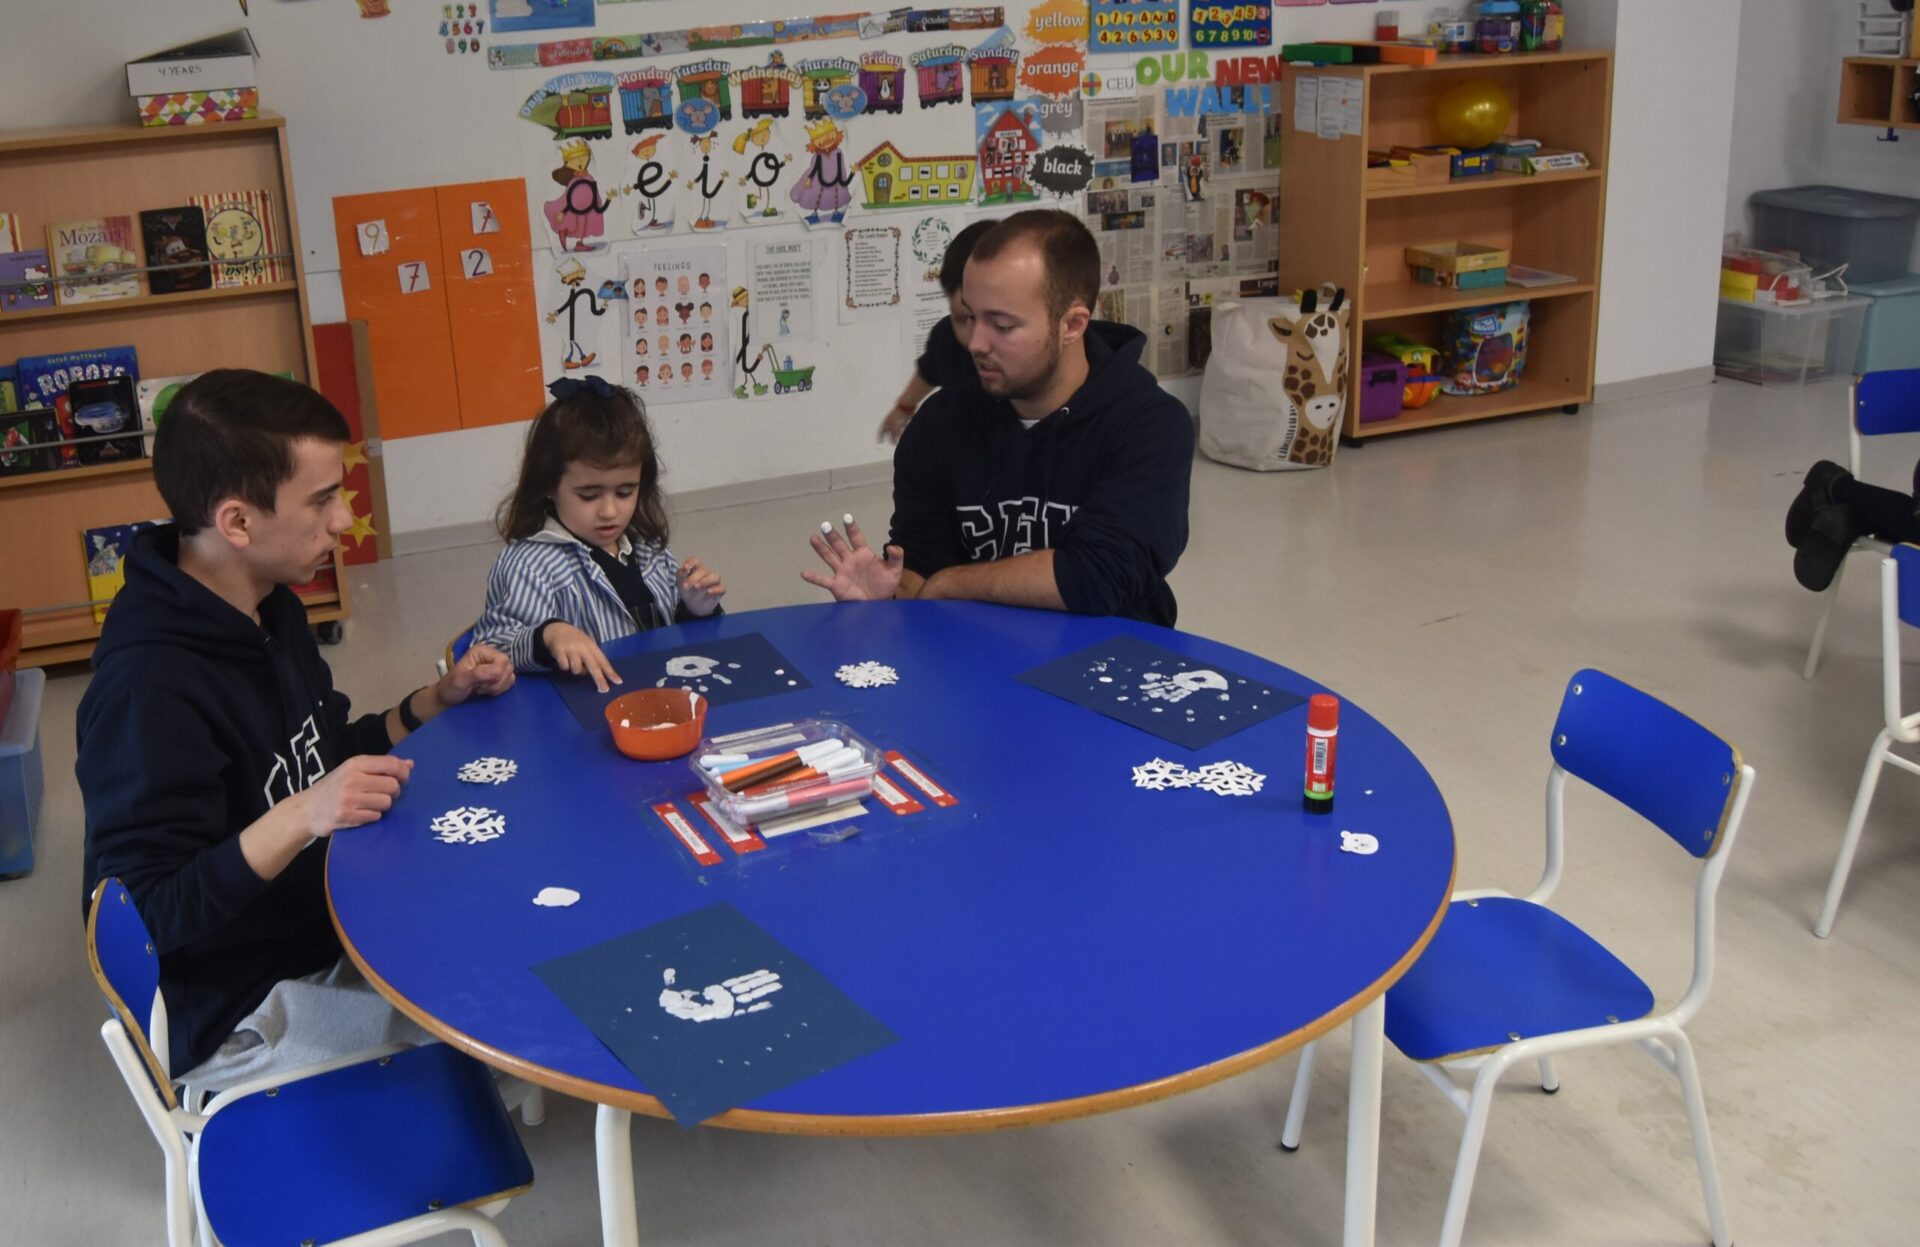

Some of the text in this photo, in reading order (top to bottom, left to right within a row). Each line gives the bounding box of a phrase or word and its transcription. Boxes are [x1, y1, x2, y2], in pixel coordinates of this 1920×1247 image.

[921, 16, 949, 26] October
[1035, 11, 1085, 32] yellow
[1114, 31, 1122, 42] 2
[1169, 29, 1176, 41] 9
[1209, 30, 1217, 42] 7
[861, 52, 903, 70] Friday
[911, 44, 968, 65] Saturday
[971, 46, 1019, 62] Sunday
[158, 65, 202, 76] 4 YEARS
[618, 66, 673, 86] Monday
[674, 59, 730, 78] Tuesday
[796, 57, 858, 76] Thursday
[1027, 62, 1079, 78] orange
[1135, 50, 1282, 86] OUR NEW
[729, 67, 803, 88] Wednesday
[1106, 77, 1134, 91] CEU
[522, 88, 547, 117] Days
[549, 82, 559, 94] of
[582, 74, 617, 88] Week
[1164, 84, 1272, 117] WALL!
[1041, 102, 1073, 118] grey
[1043, 157, 1082, 176] black
[694, 155, 724, 199] i
[59, 229, 125, 247] Mozart
[365, 223, 380, 251] 9
[468, 250, 487, 277] 2
[653, 262, 691, 272] FEELINGS
[404, 263, 420, 291] 7
